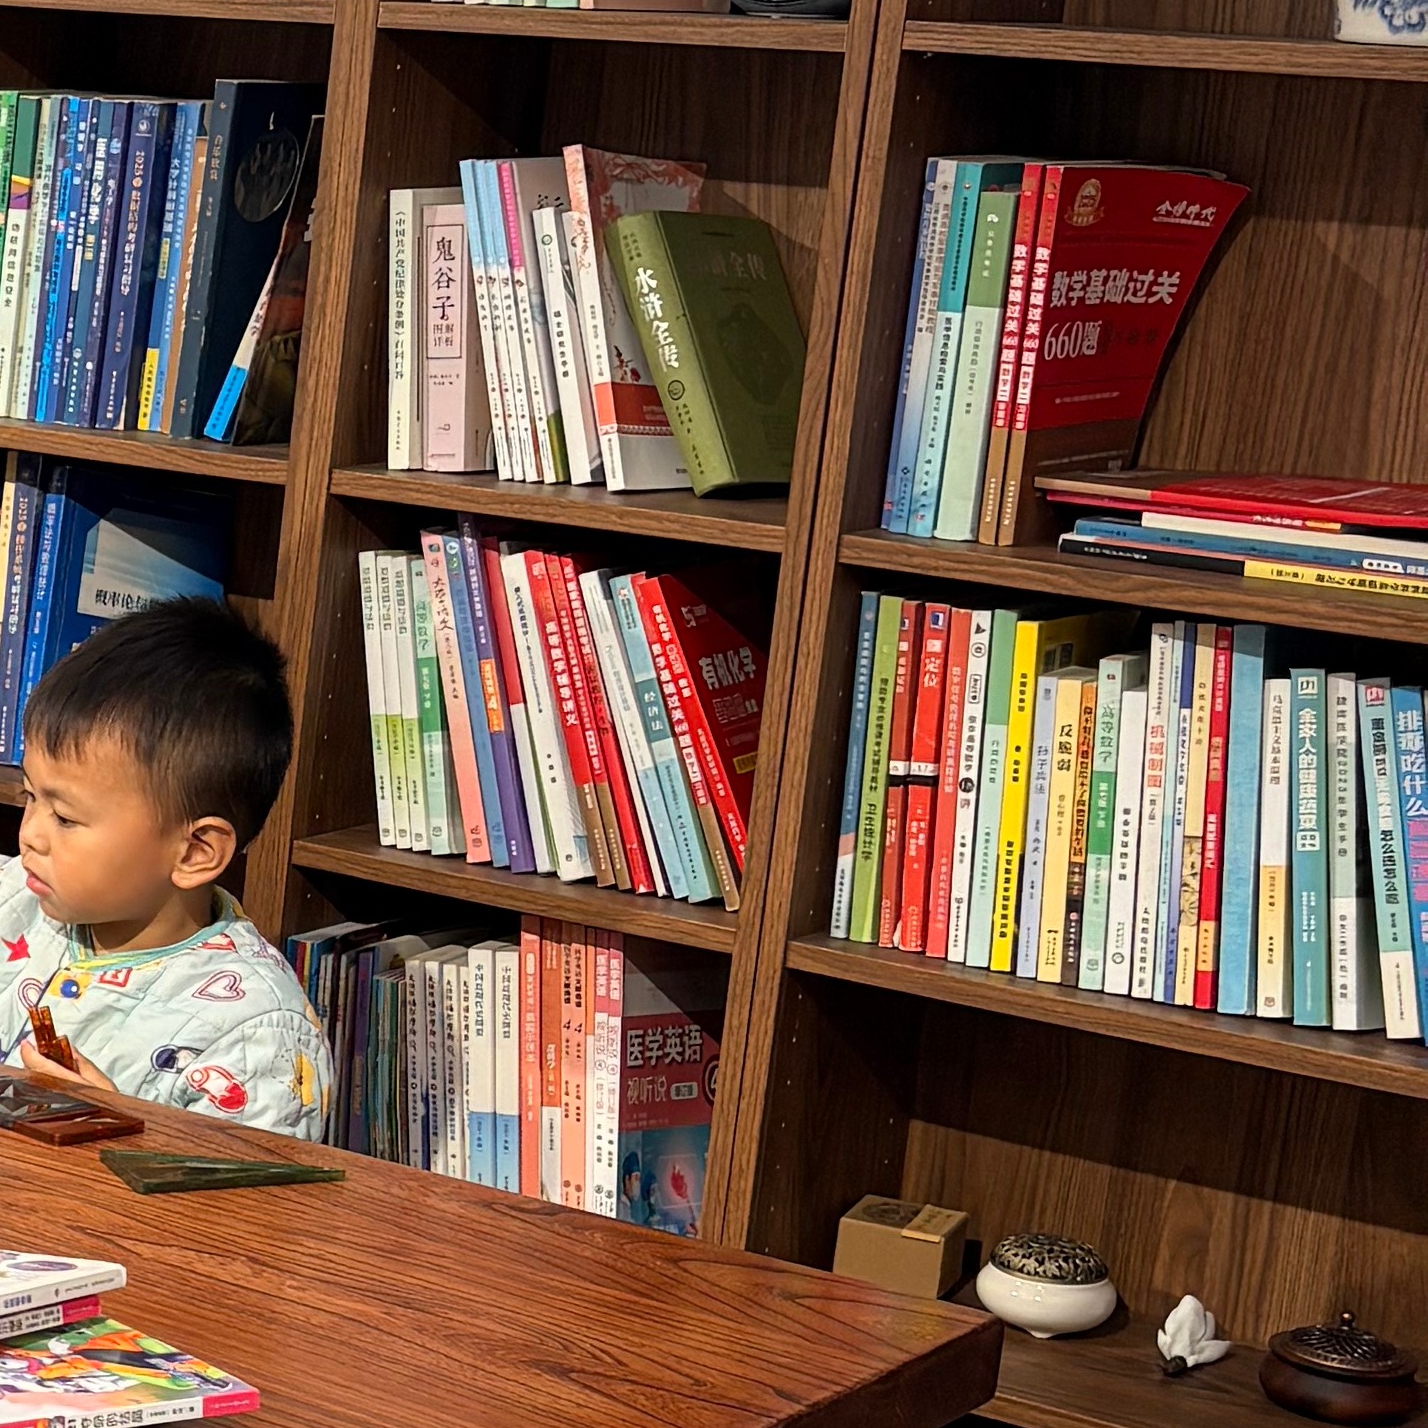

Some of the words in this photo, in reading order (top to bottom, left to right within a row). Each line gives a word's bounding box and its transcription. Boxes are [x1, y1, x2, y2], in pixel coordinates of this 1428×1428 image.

[432, 236, 456, 321] 鬼谷子
[1051, 269, 1181, 309] 数学基础过关
[1044, 319, 1102, 361] 660题
[627, 1025, 703, 1067] 医学英语
[627, 1075, 668, 1105] 视听说
